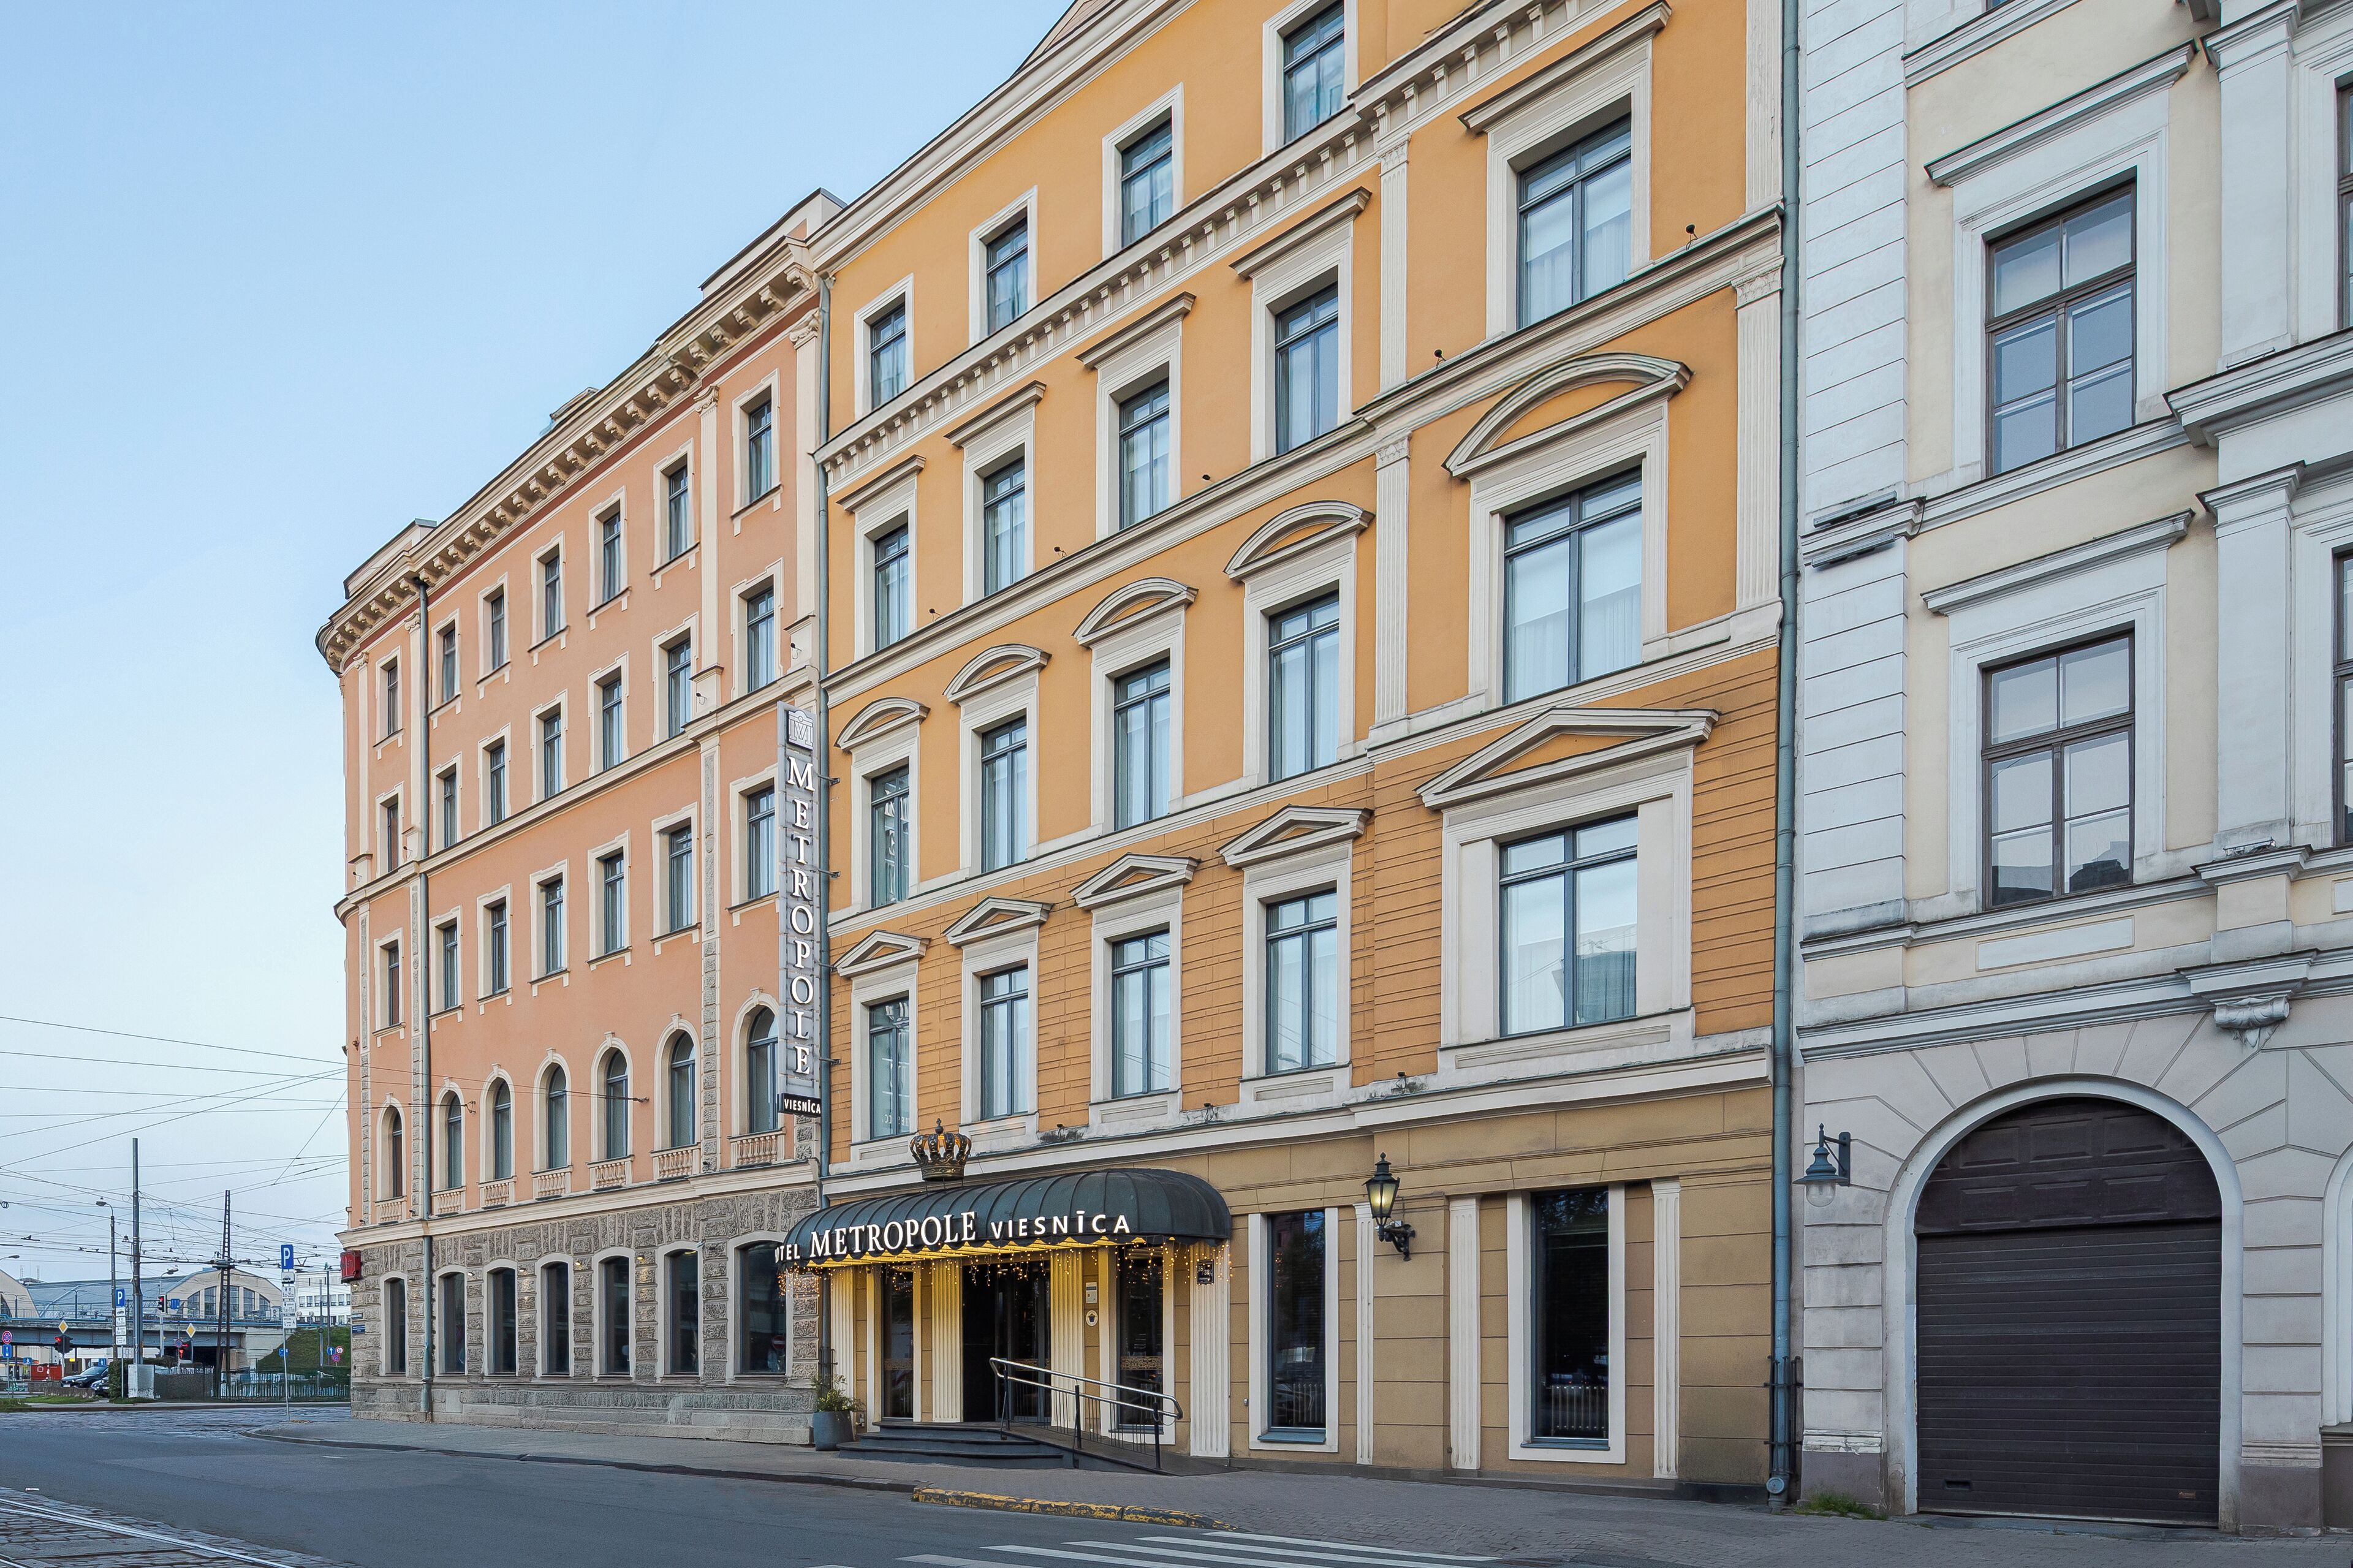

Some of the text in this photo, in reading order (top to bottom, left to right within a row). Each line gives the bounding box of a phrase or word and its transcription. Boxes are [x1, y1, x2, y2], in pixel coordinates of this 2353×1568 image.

[787, 756, 816, 1075] METROPOLE
[784, 1099, 821, 1114] VIESNĪCA
[809, 1211, 976, 1257] METROPOLE
[990, 1210, 1131, 1240] VIESNĪCA
[283, 1247, 290, 1267] P
[117, 1291, 123, 1305] P
